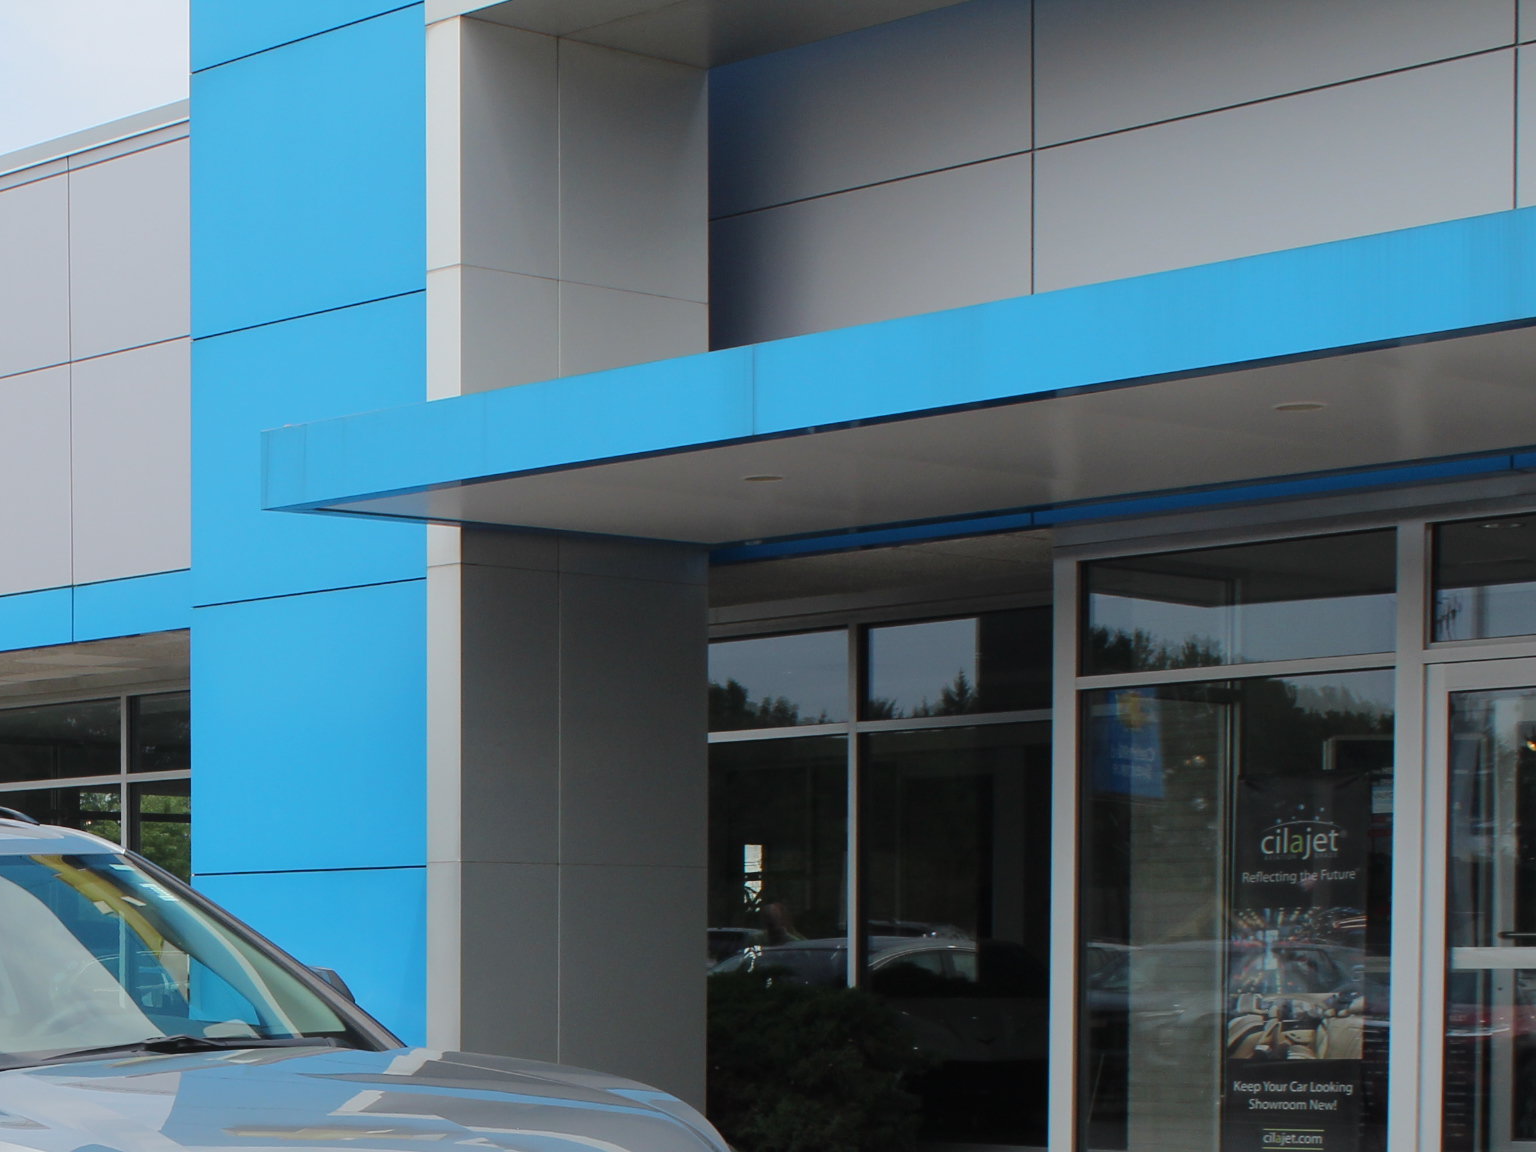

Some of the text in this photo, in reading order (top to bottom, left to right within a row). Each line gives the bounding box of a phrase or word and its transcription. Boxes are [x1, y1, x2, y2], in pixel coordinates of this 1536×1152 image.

[1260, 826, 1339, 860] cilajet
[1242, 869, 1356, 885] Reflecting the Future
[1233, 1081, 1353, 1095] Keep Your Car Looking
[1248, 1099, 1337, 1111] Showroom New!
[1262, 1132, 1323, 1145] cilajet.com
